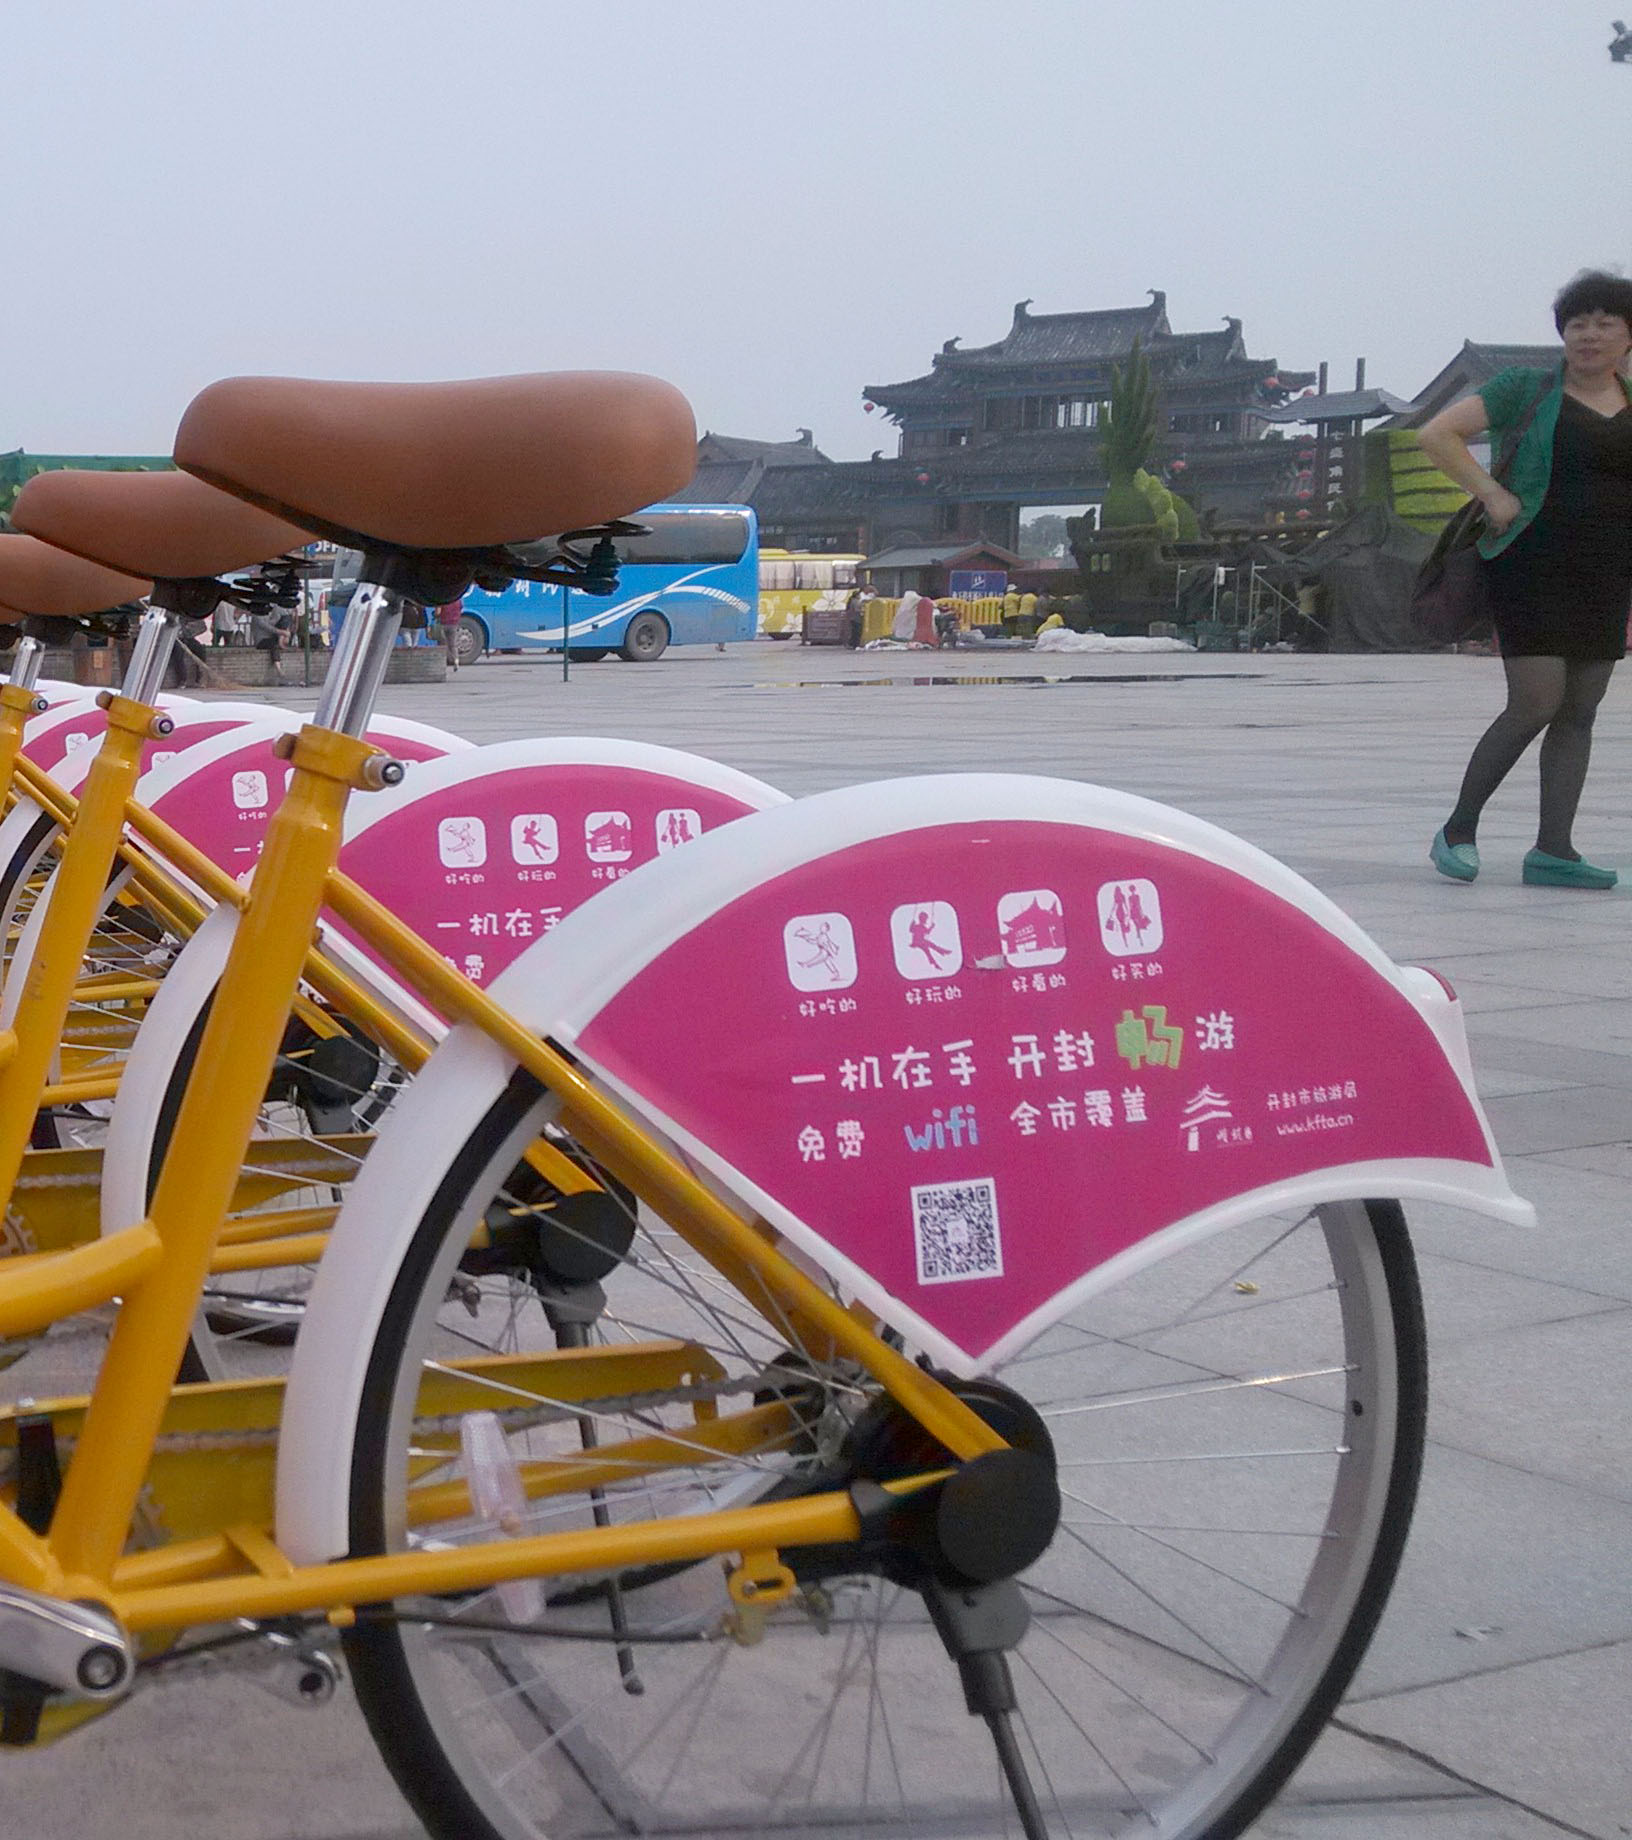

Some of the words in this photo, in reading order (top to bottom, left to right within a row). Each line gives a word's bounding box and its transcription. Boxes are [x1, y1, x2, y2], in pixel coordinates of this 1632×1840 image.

[799, 998, 857, 1017] 好吃的
[905, 986, 961, 1005] 好玩的
[1012, 974, 1066, 993] 好看的
[1111, 962, 1162, 981] 好买的
[791, 1040, 977, 1091] 一机在手
[798, 1120, 865, 1162] 免费
[904, 1104, 980, 1152] wifi
[1009, 1085, 1148, 1136] 全市覆盖
